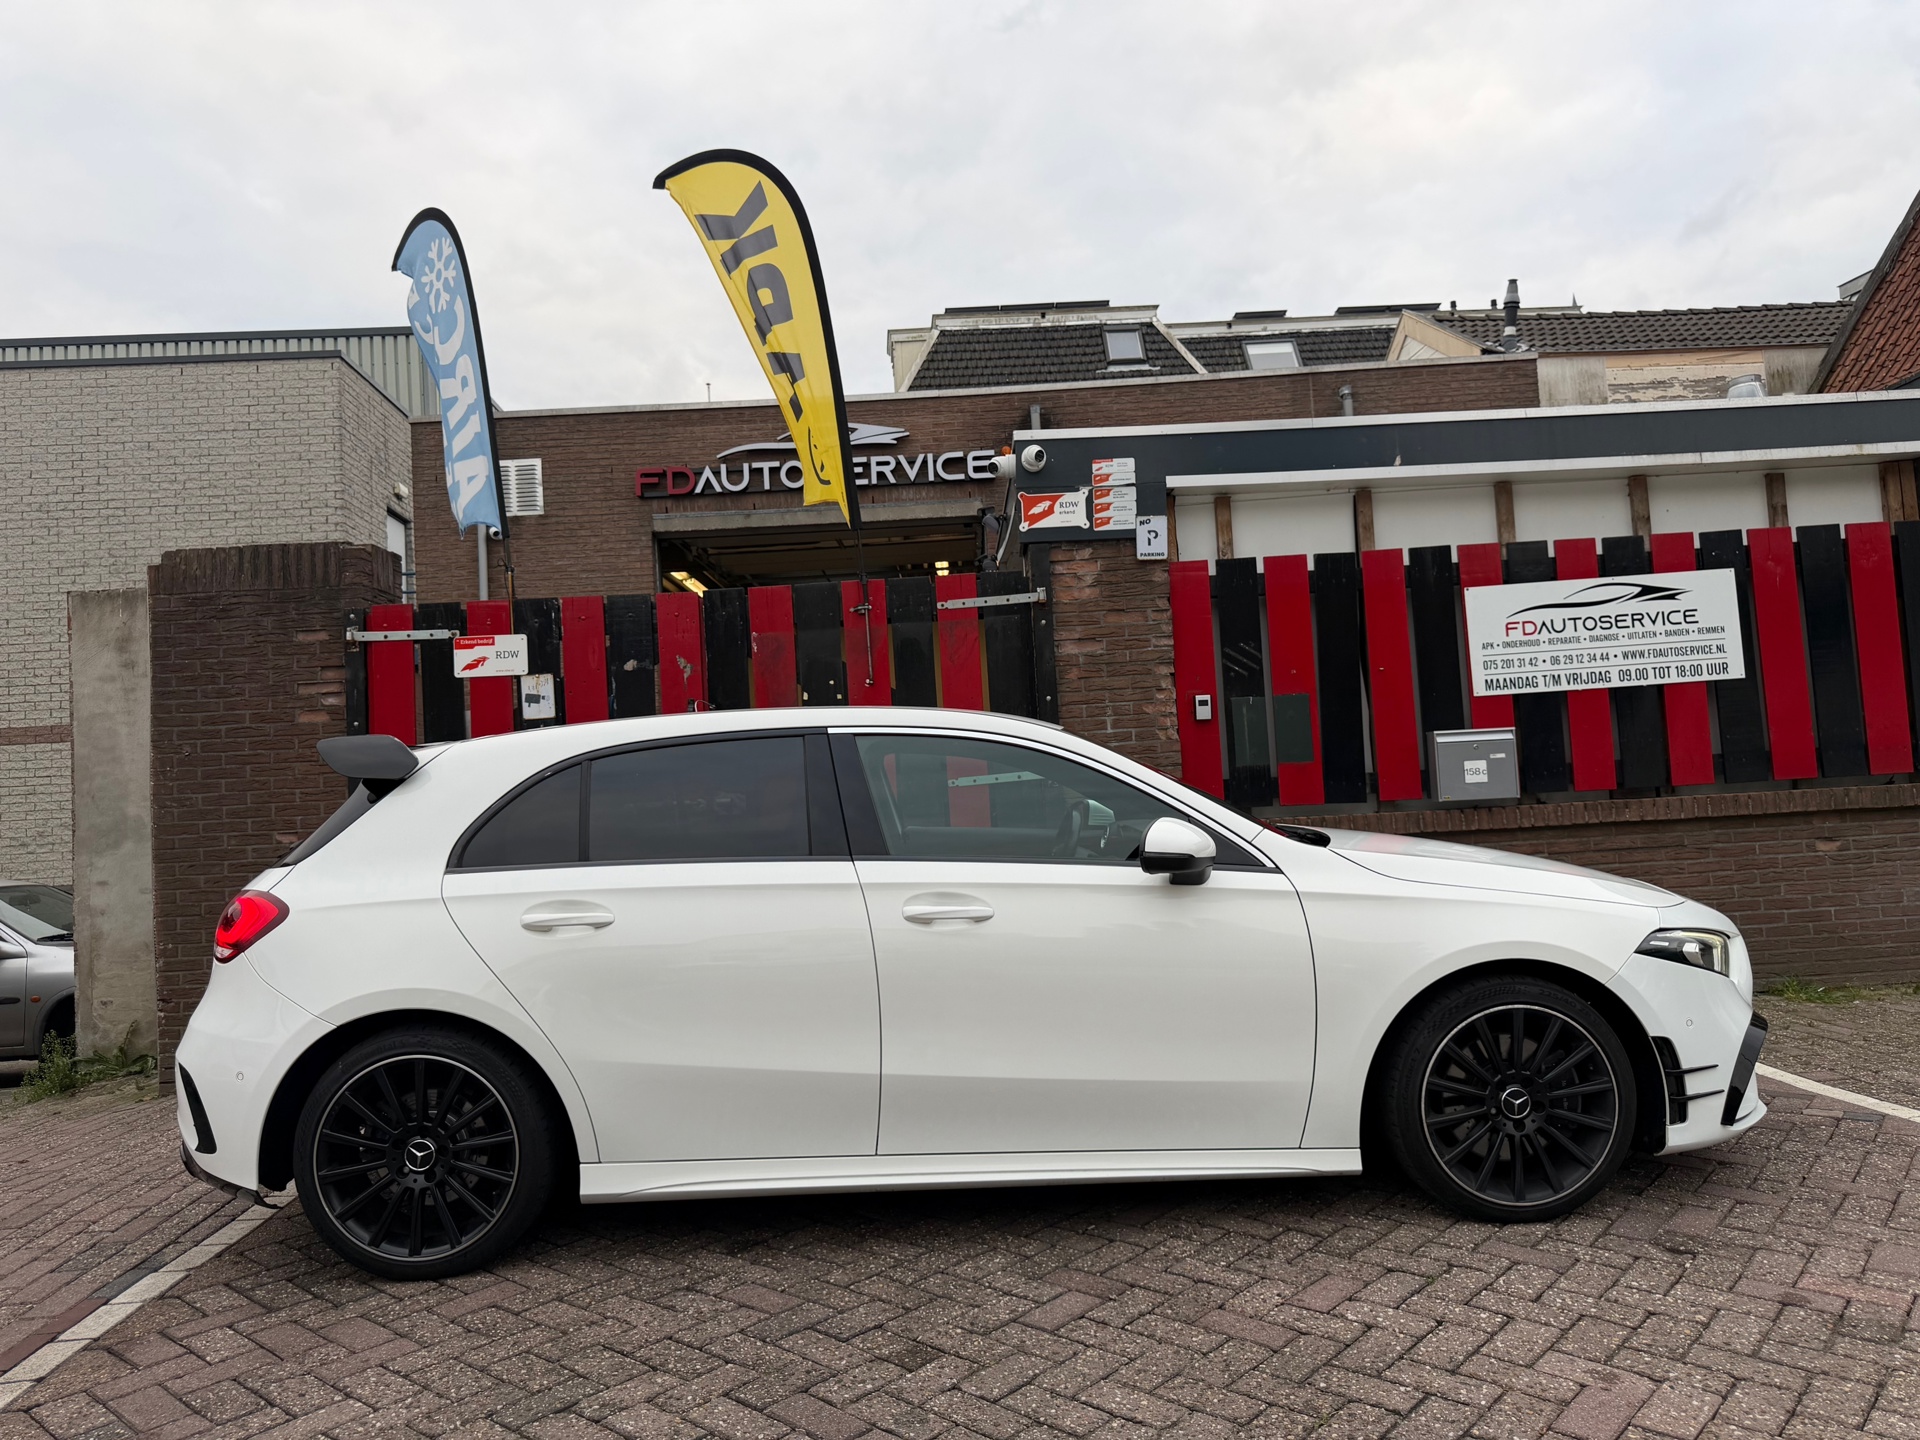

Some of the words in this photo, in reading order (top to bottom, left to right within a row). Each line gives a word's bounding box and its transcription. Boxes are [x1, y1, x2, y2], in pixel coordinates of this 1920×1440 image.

[635, 450, 997, 497] FDAUTOERVICE
[1059, 501, 1080, 509] RDW
[1139, 518, 1151, 526] NO
[1505, 609, 1699, 637] FDAUTOSERVICE
[1482, 642, 1494, 650] APK
[1502, 639, 1540, 649] ONDERHOUD
[1548, 636, 1581, 645] REPARATIE
[1589, 632, 1620, 642] DIAGNOSE
[1627, 630, 1657, 640] UITLATEN
[1665, 628, 1690, 637] BANDEN
[1697, 625, 1725, 635] REMMEN
[495, 650, 520, 660] RDW
[1483, 660, 1498, 670] 075
[1501, 659, 1515, 669] 201
[1517, 658, 1526, 668] 31
[1528, 656, 1539, 667] 42
[1550, 655, 1561, 666] 06
[1563, 654, 1574, 665] 29
[1576, 653, 1584, 664] 12
[1587, 652, 1597, 663] 34
[1599, 651, 1610, 662] 44
[1621, 643, 1727, 660] WWW.FDAUTOSERVICE.NL
[1484, 675, 1539, 691] MAANDAG
[1541, 673, 1562, 688] T/M
[1564, 670, 1612, 686] VRIJDAG
[1618, 667, 1649, 682] 09.00
[1651, 665, 1672, 680] TOT
[1675, 663, 1703, 678] 18:00
[1706, 661, 1729, 676] UUR
